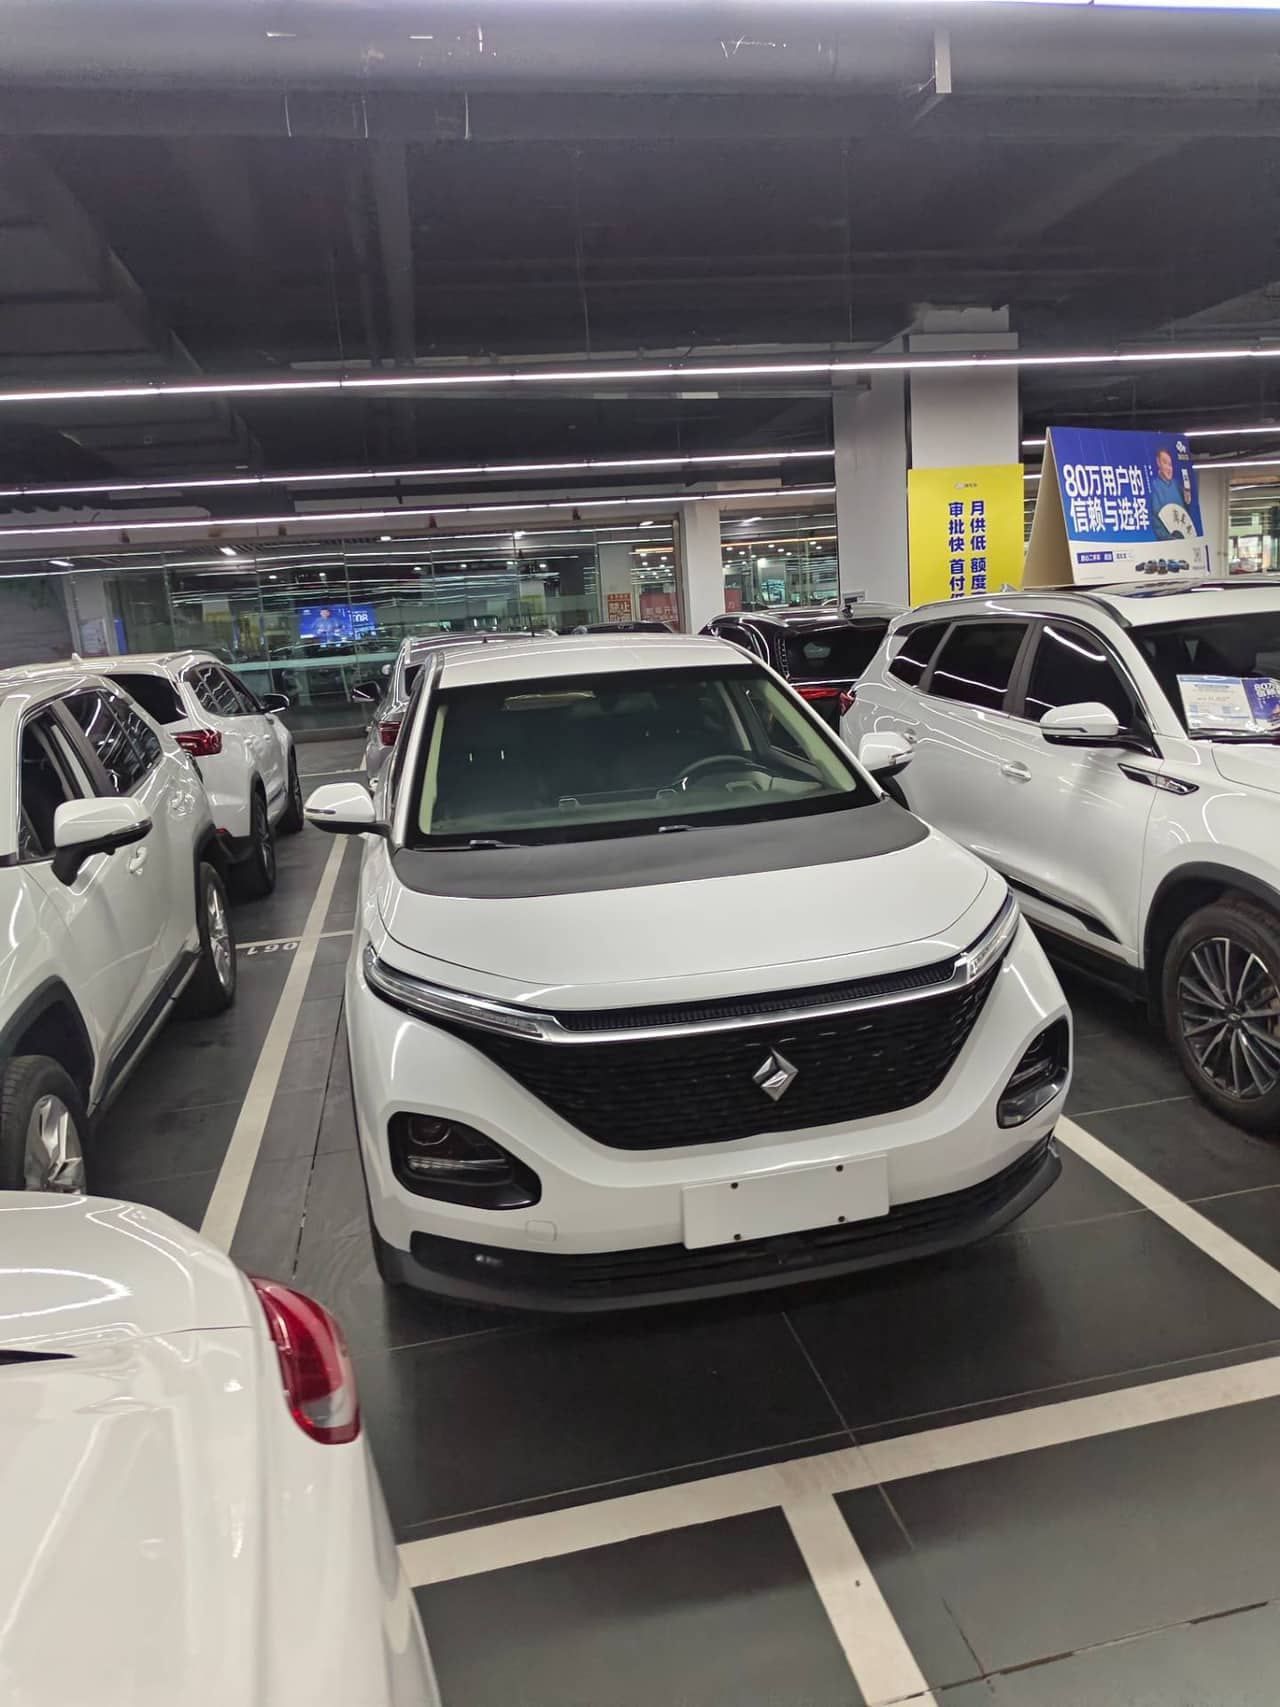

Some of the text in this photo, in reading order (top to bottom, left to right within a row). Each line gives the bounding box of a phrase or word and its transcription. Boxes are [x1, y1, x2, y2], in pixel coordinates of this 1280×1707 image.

[1063, 464, 1145, 497] 80万用户的
[949, 501, 965, 553] 审批快
[970, 500, 986, 551] 月供低
[1070, 497, 1150, 533] 信赖与选择
[970, 557, 986, 595] 额度
